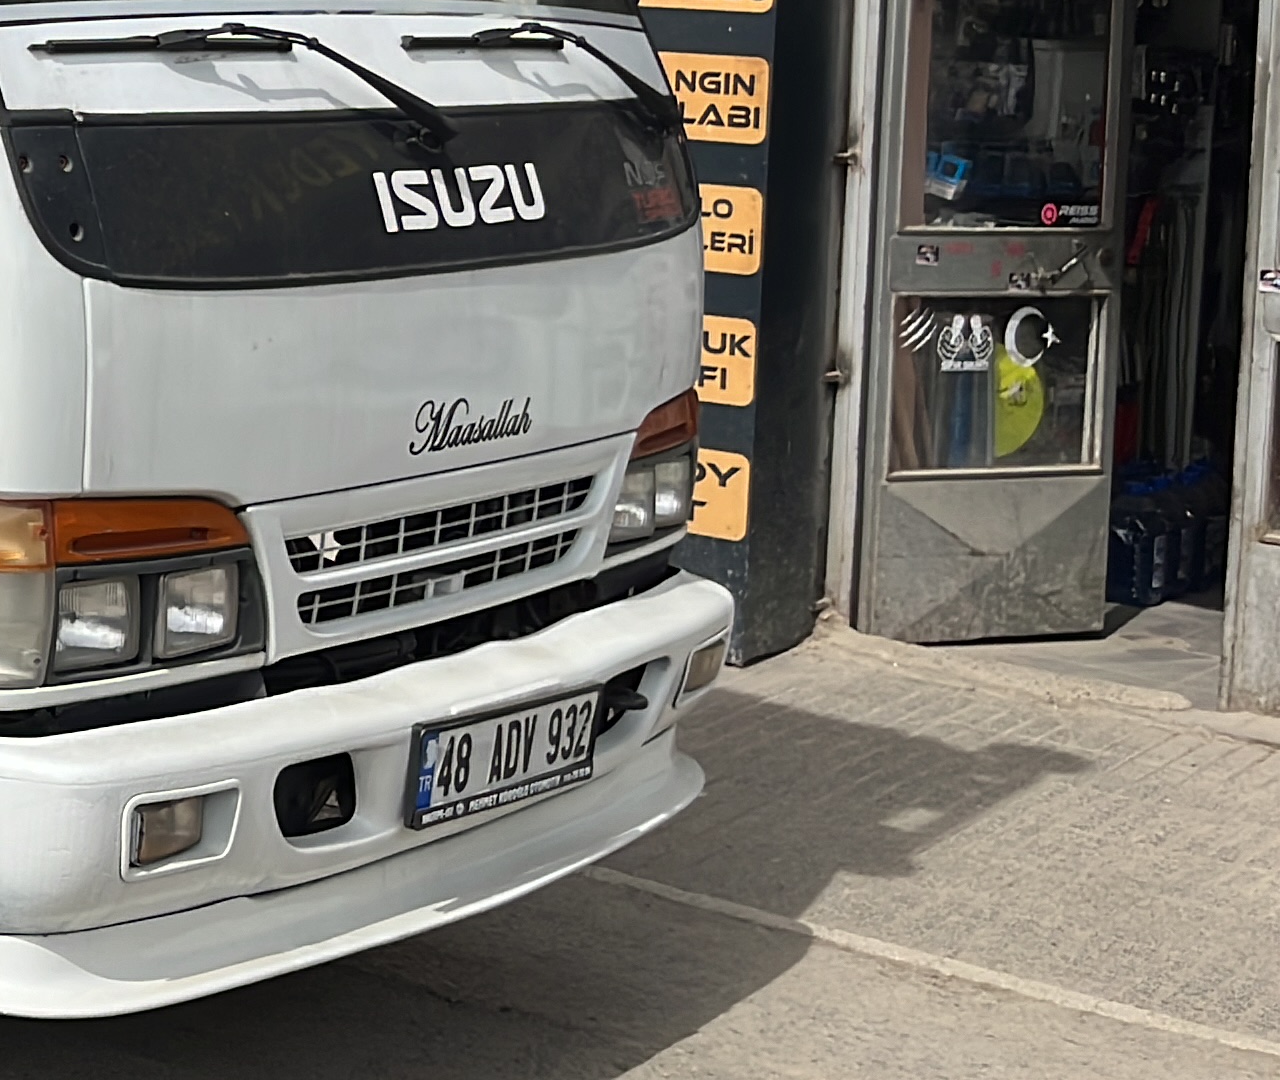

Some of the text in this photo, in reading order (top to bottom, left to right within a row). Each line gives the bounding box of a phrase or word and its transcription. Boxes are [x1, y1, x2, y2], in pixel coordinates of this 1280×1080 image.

[675, 69, 756, 96] NGIN
[679, 101, 761, 130] LABI
[372, 163, 546, 233] ISUZU
[409, 397, 533, 456] Maasallah
[437, 700, 593, 797] 48 ADV 932
[419, 775, 432, 793] TR
